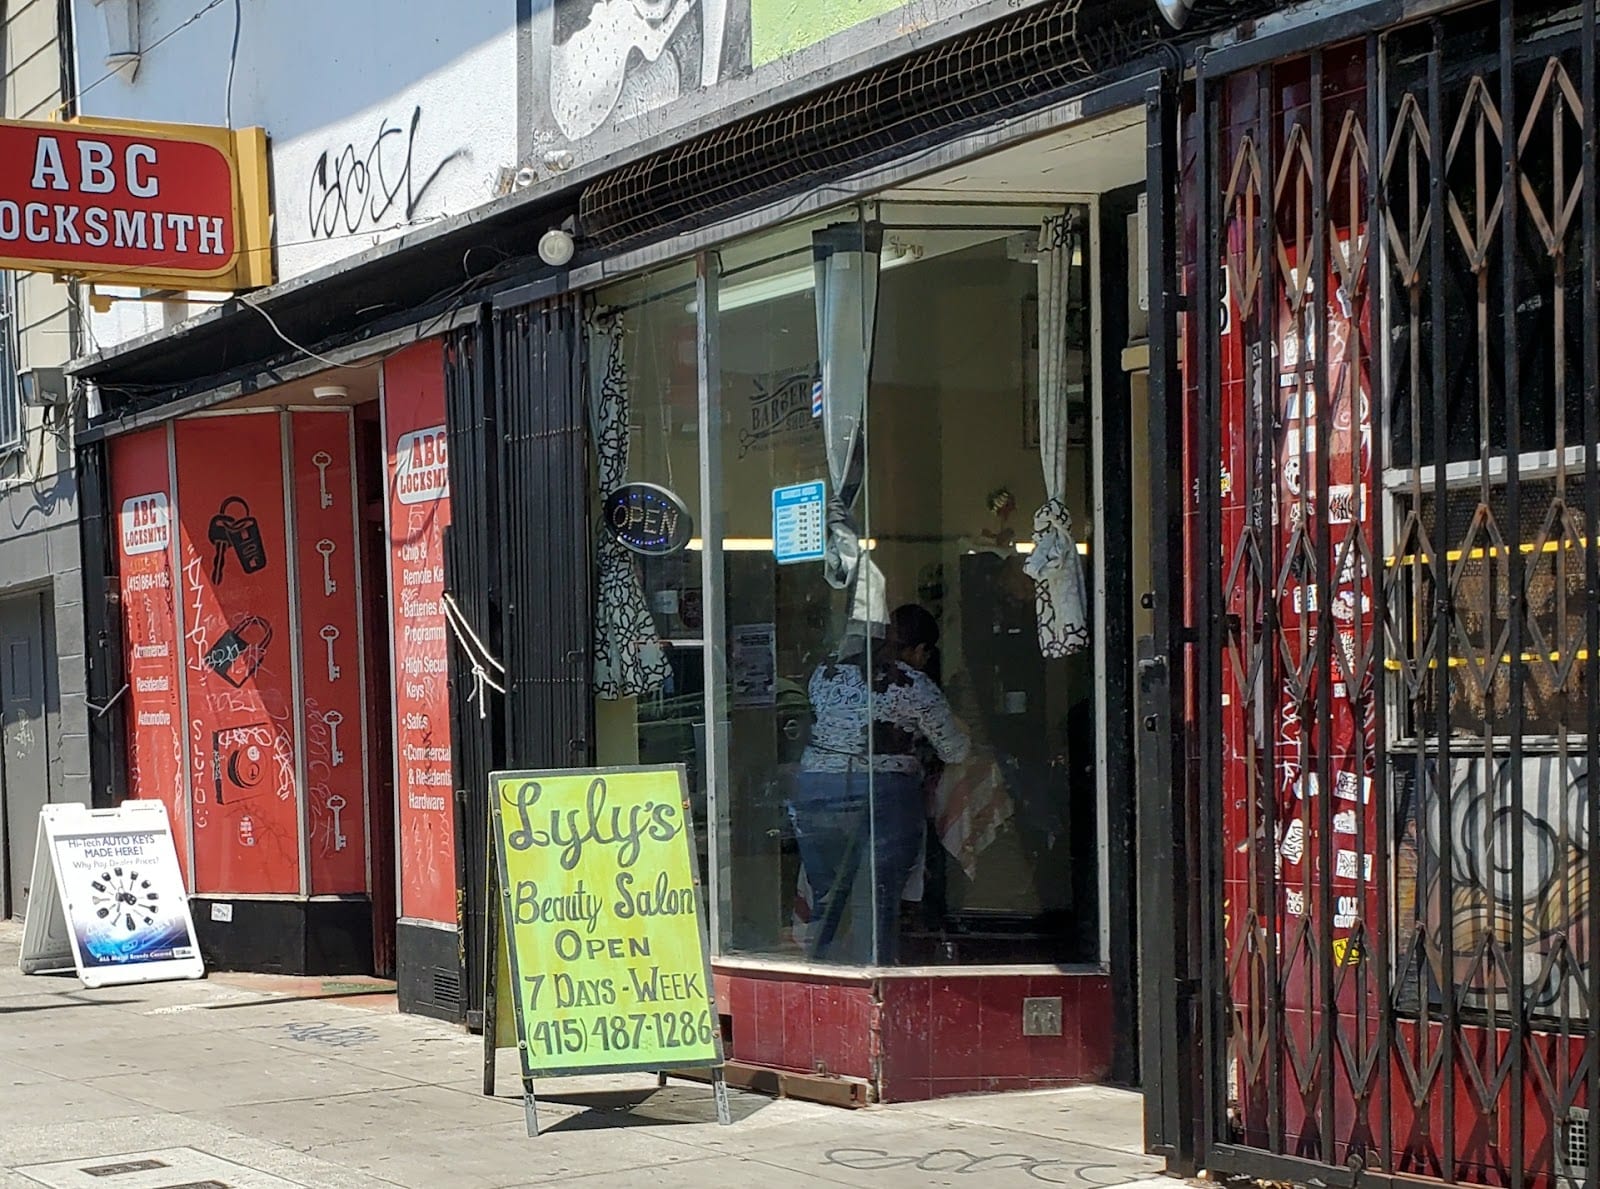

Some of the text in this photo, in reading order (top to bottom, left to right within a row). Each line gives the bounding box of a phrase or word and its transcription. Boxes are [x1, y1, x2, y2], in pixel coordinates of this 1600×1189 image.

[31, 136, 159, 198] ABC
[0, 200, 225, 255] OCKSMITH
[752, 382, 807, 431] BARBER
[411, 431, 447, 469] ABC
[133, 498, 157, 528] ABC
[612, 504, 678, 538] OPEN
[125, 525, 167, 548] LOCKSMITH
[402, 542, 427, 563] Chip &
[403, 565, 444, 586] Remote Ke
[404, 600, 437, 617] Batteries
[134, 641, 169, 658] Commercial
[405, 656, 423, 677] High
[136, 675, 169, 692] Residential
[406, 681, 425, 701] Keys
[138, 710, 171, 726] Automotive
[406, 712, 428, 730] Safes
[408, 770, 415, 785] &
[409, 792, 445, 810] Hardware
[502, 777, 683, 871] Lyly's
[68, 834, 155, 848] Hi-Tech AUTO KEYS
[84, 846, 144, 858] MADE HERE!
[72, 861, 92, 870] Why
[514, 871, 695, 934] Beauty Salon
[554, 929, 651, 961] OPEN
[524, 974, 545, 1011] 7
